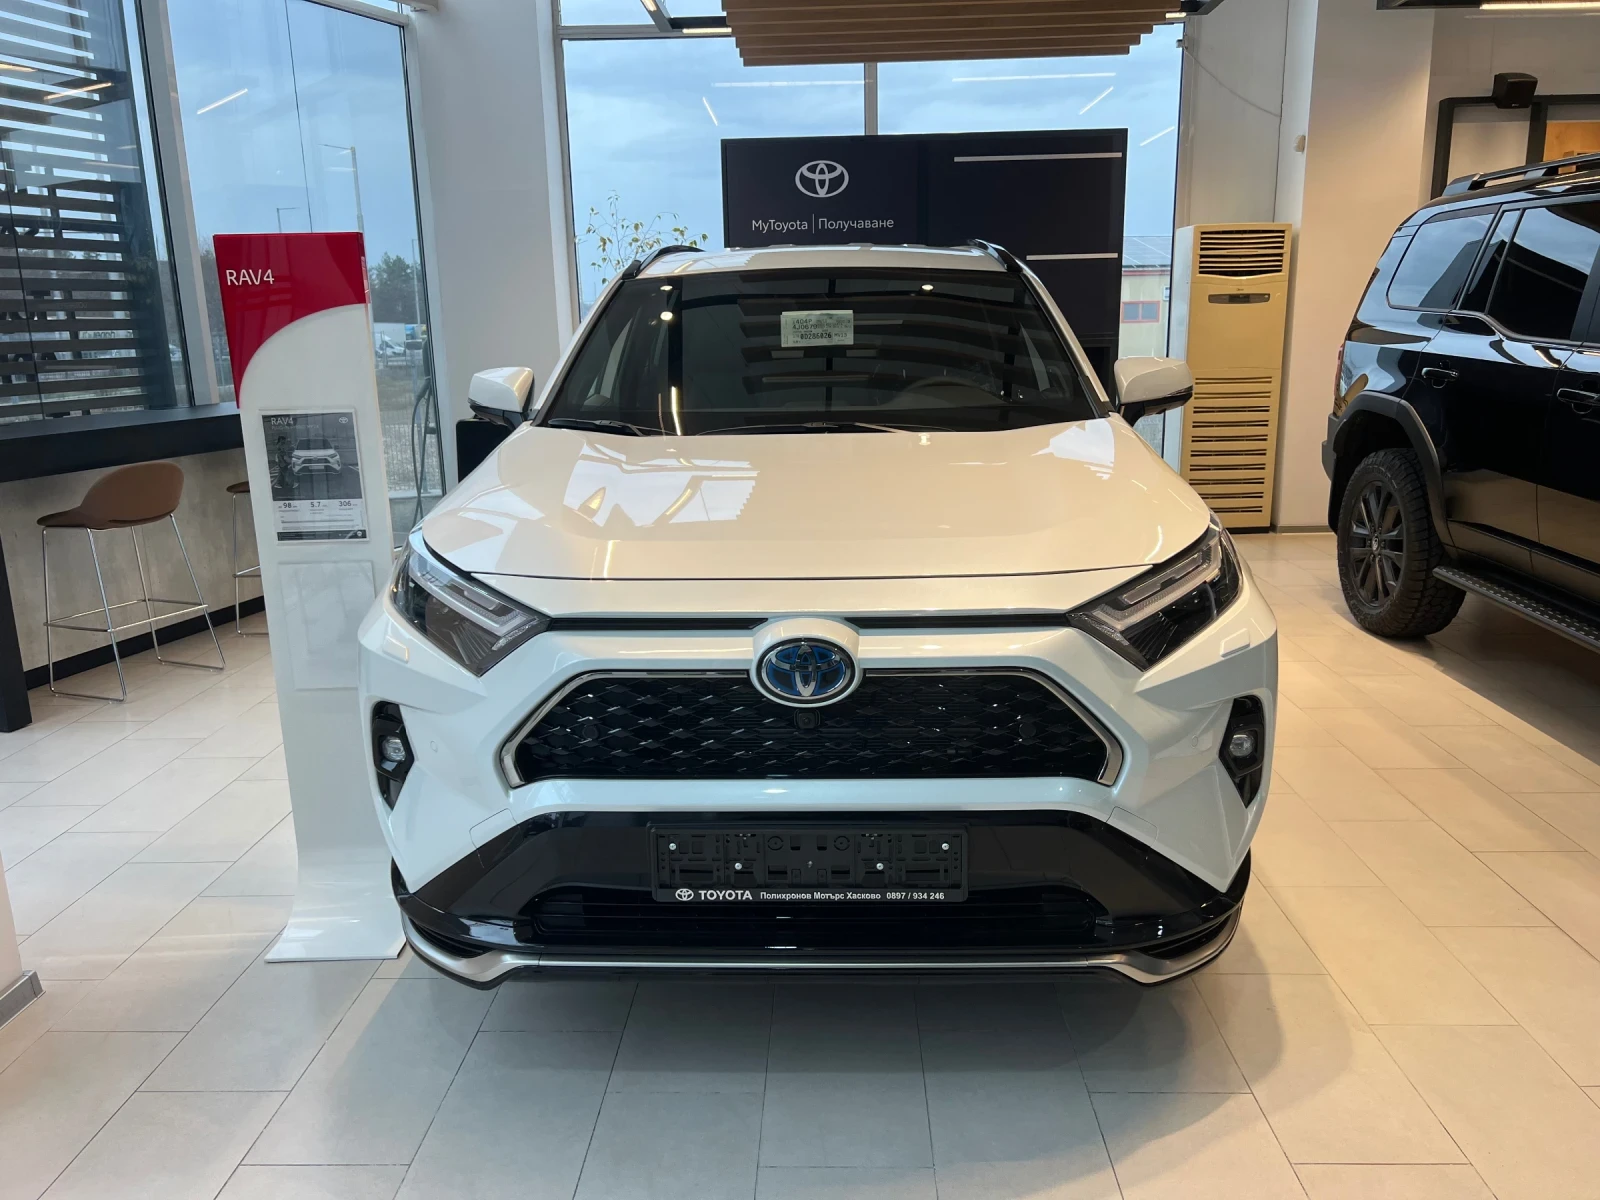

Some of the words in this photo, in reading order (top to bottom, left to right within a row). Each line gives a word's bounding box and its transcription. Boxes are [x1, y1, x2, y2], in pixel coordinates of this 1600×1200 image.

[751, 219, 808, 233] MyToyota
[818, 218, 895, 231] Получаване
[226, 269, 275, 286] RAV4
[271, 416, 294, 425] RAV4
[698, 890, 753, 900] TOYOTA
[760, 891, 812, 901] Полихронов
[813, 891, 845, 901] Мотърс
[846, 891, 881, 900] Хасково
[886, 892, 905, 900] 0897
[912, 892, 928, 900] 934
[929, 892, 945, 900] 246
